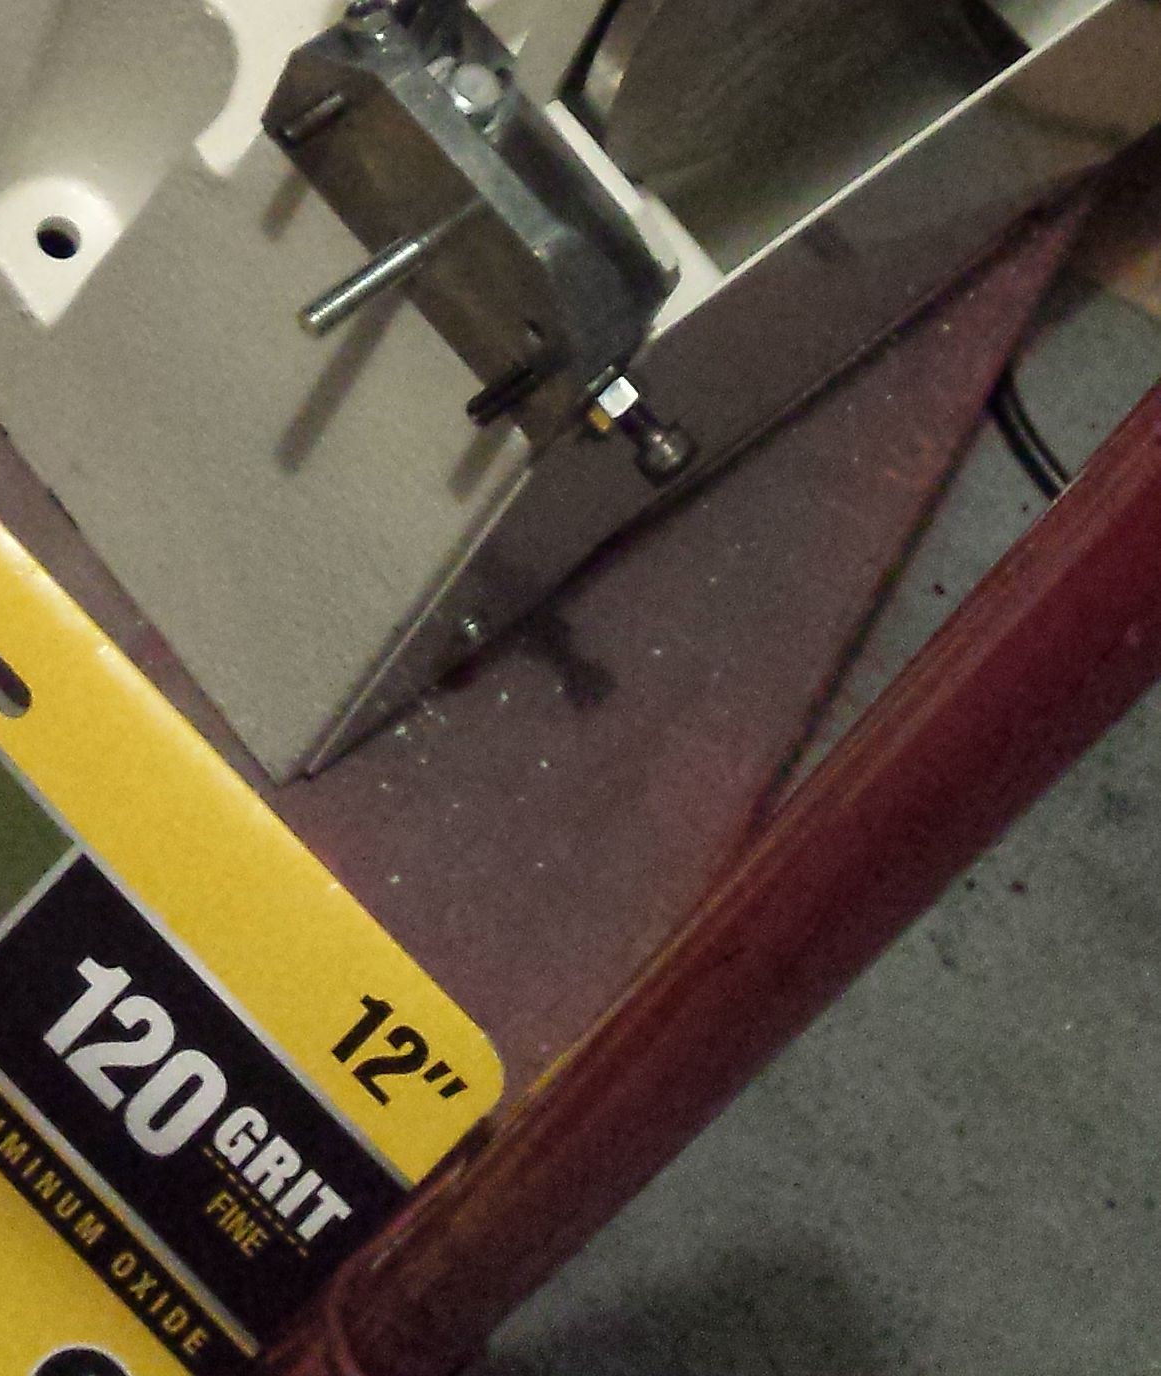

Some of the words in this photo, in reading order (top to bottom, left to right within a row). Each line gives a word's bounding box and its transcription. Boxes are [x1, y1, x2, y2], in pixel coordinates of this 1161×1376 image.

[43, 956, 228, 1156] 120
[213, 1105, 353, 1241] GRIT
[206, 1191, 270, 1258] FINE
[110, 1252, 208, 1355] OXIDE
